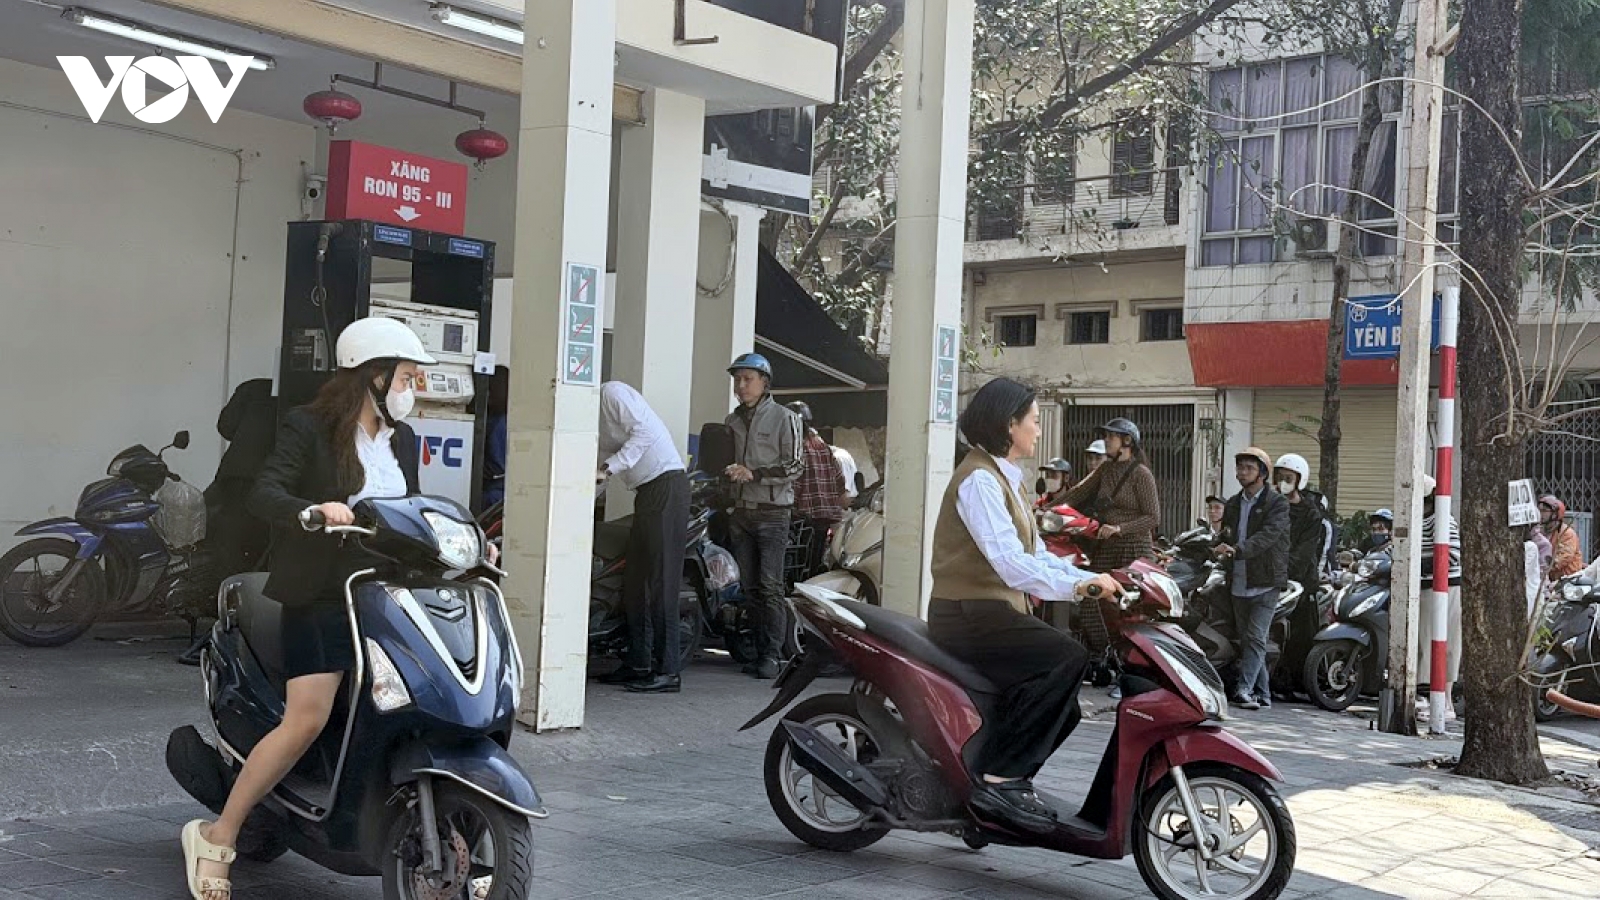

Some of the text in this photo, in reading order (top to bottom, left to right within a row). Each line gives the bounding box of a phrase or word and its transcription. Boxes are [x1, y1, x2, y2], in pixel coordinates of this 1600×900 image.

[390, 160, 430, 183] XĂNG
[364, 176, 398, 199] RON
[402, 185, 421, 203] 95
[435, 191, 452, 209] III
[1354, 322, 1387, 348] YÊN
[414, 434, 463, 468] FC
